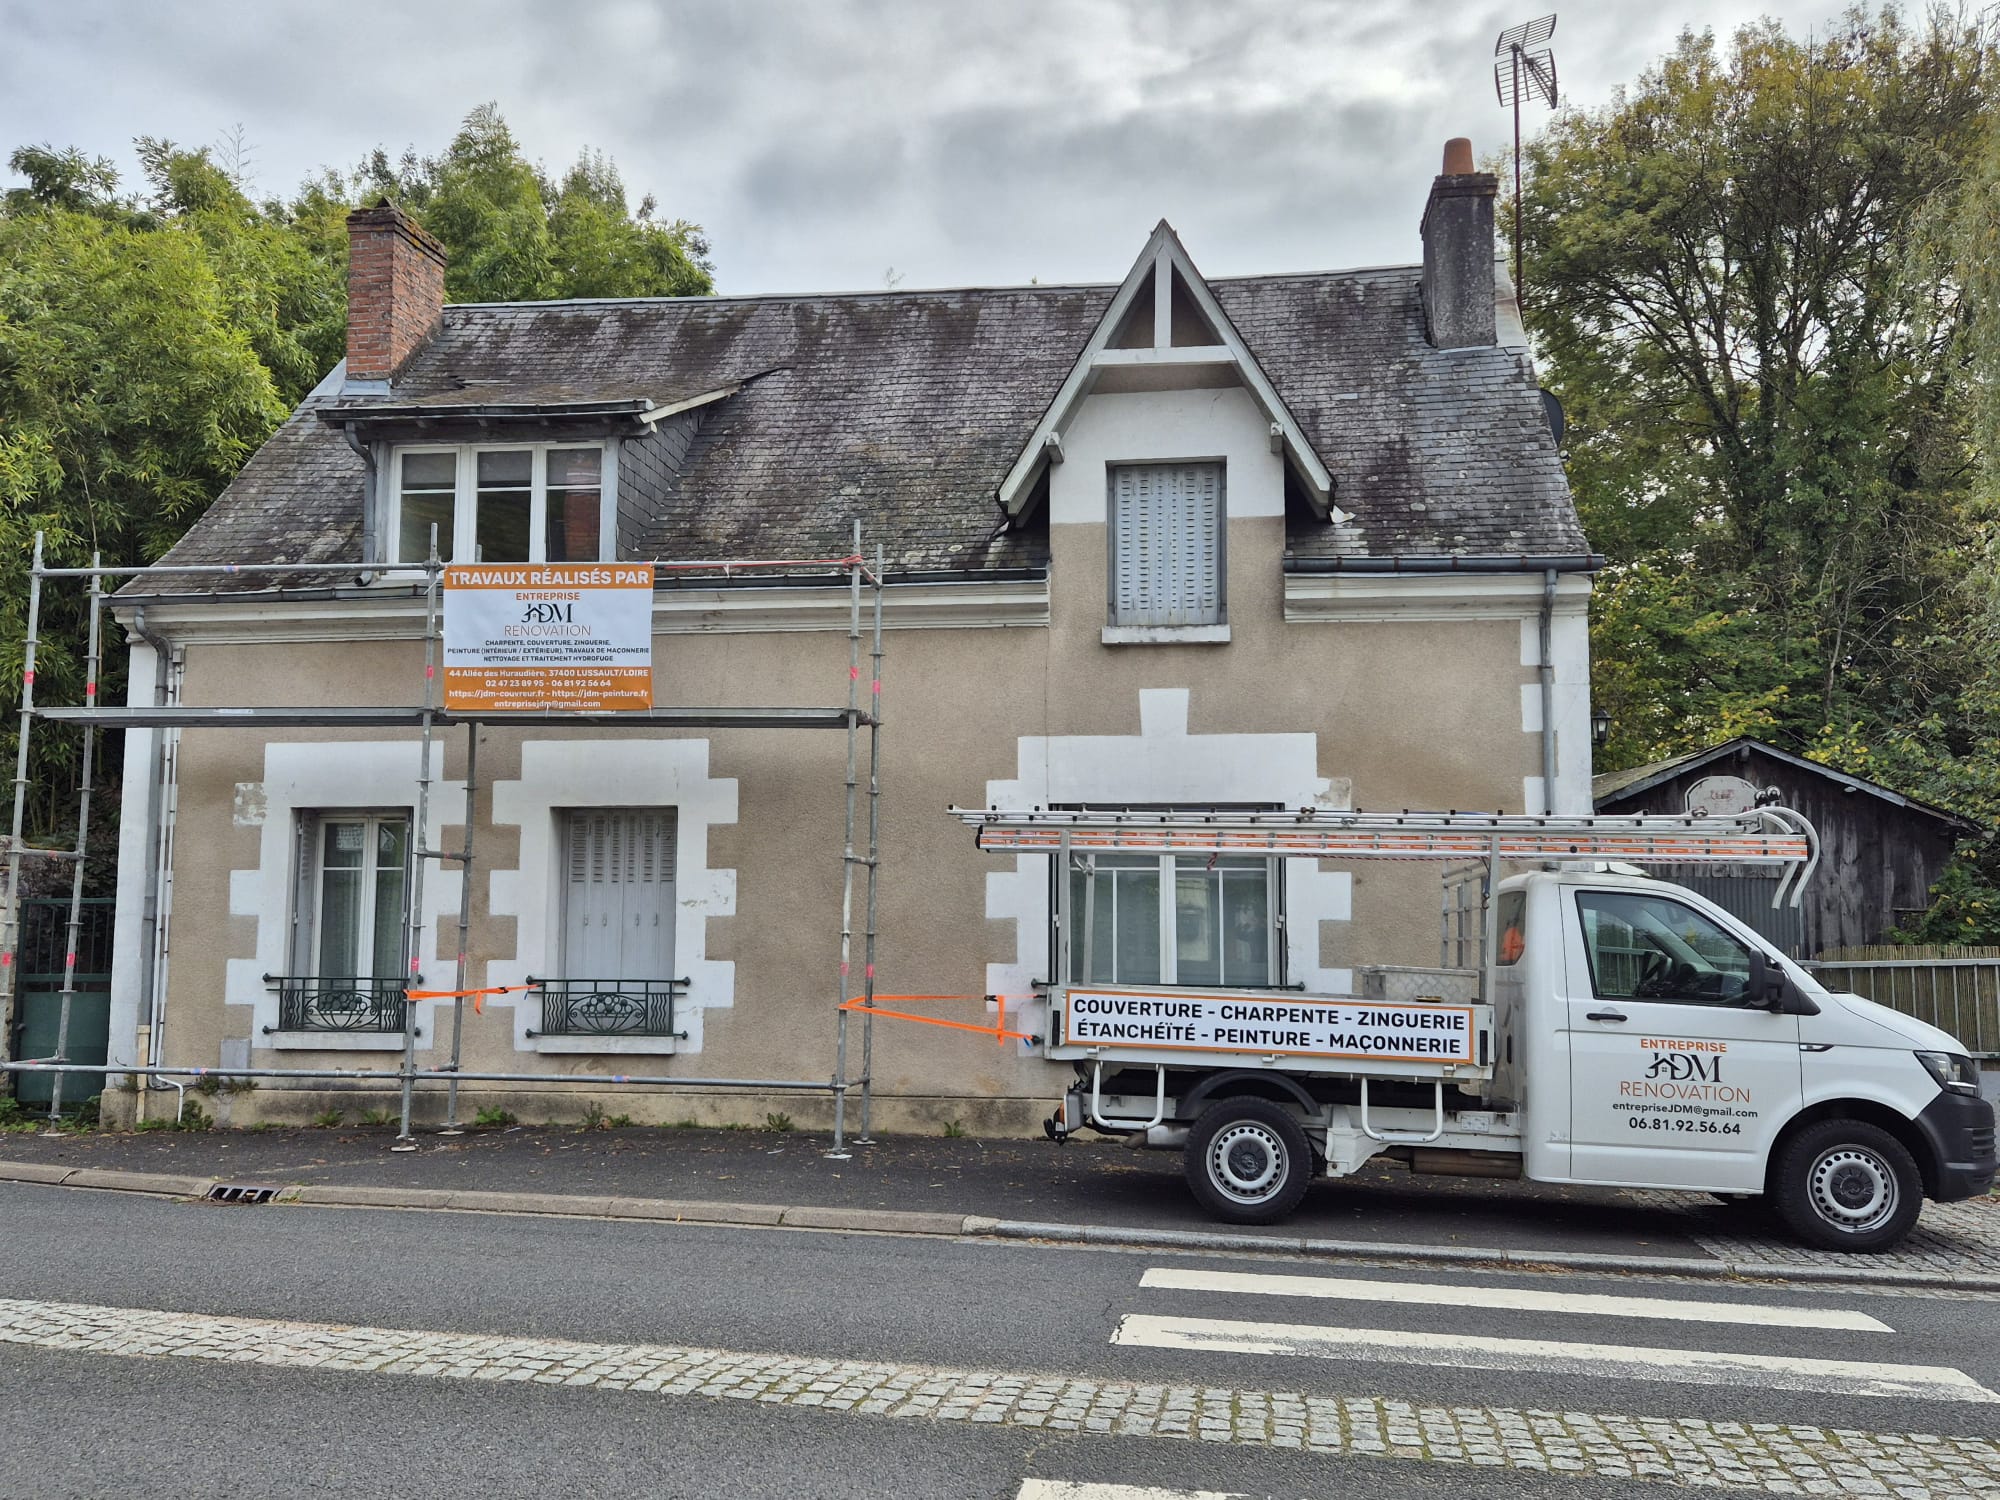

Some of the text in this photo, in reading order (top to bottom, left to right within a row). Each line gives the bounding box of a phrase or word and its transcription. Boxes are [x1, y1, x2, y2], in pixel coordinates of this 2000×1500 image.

[450, 568, 649, 585] TRAVAUX RÉALISÉS PAR
[516, 592, 580, 601] ENTREPRISE
[521, 603, 574, 623] JDM
[504, 625, 591, 636] RENOVATION
[481, 647, 517, 655] (INTÉRIEUR
[462, 669, 482, 677] Allée
[549, 669, 575, 677] 37400
[576, 669, 649, 677] LUSSAULT/LOIRE
[551, 689, 649, 699] https://jdm-peinture.fr
[494, 700, 601, 709] entreprisejdm@gmail.com
[1074, 998, 1203, 1018] COUVERTURE
[1220, 1005, 1339, 1025] CHARPENTE
[1357, 1011, 1464, 1030] ZINGUERIE
[1077, 1018, 1196, 1041] ÉTANCHÉÏTÉ
[1214, 1028, 1310, 1046] PEINTURE
[1329, 1033, 1460, 1054] MAÇONNERIE
[1640, 1038, 1727, 1053] ENTREPRISE
[1645, 1052, 1723, 1083] JDM
[1620, 1081, 1750, 1103] RENOVATION
[1612, 1102, 1758, 1118] entrepriseJDM@gmail.com
[1629, 1117, 1741, 1135] 06.81.92.56.64
